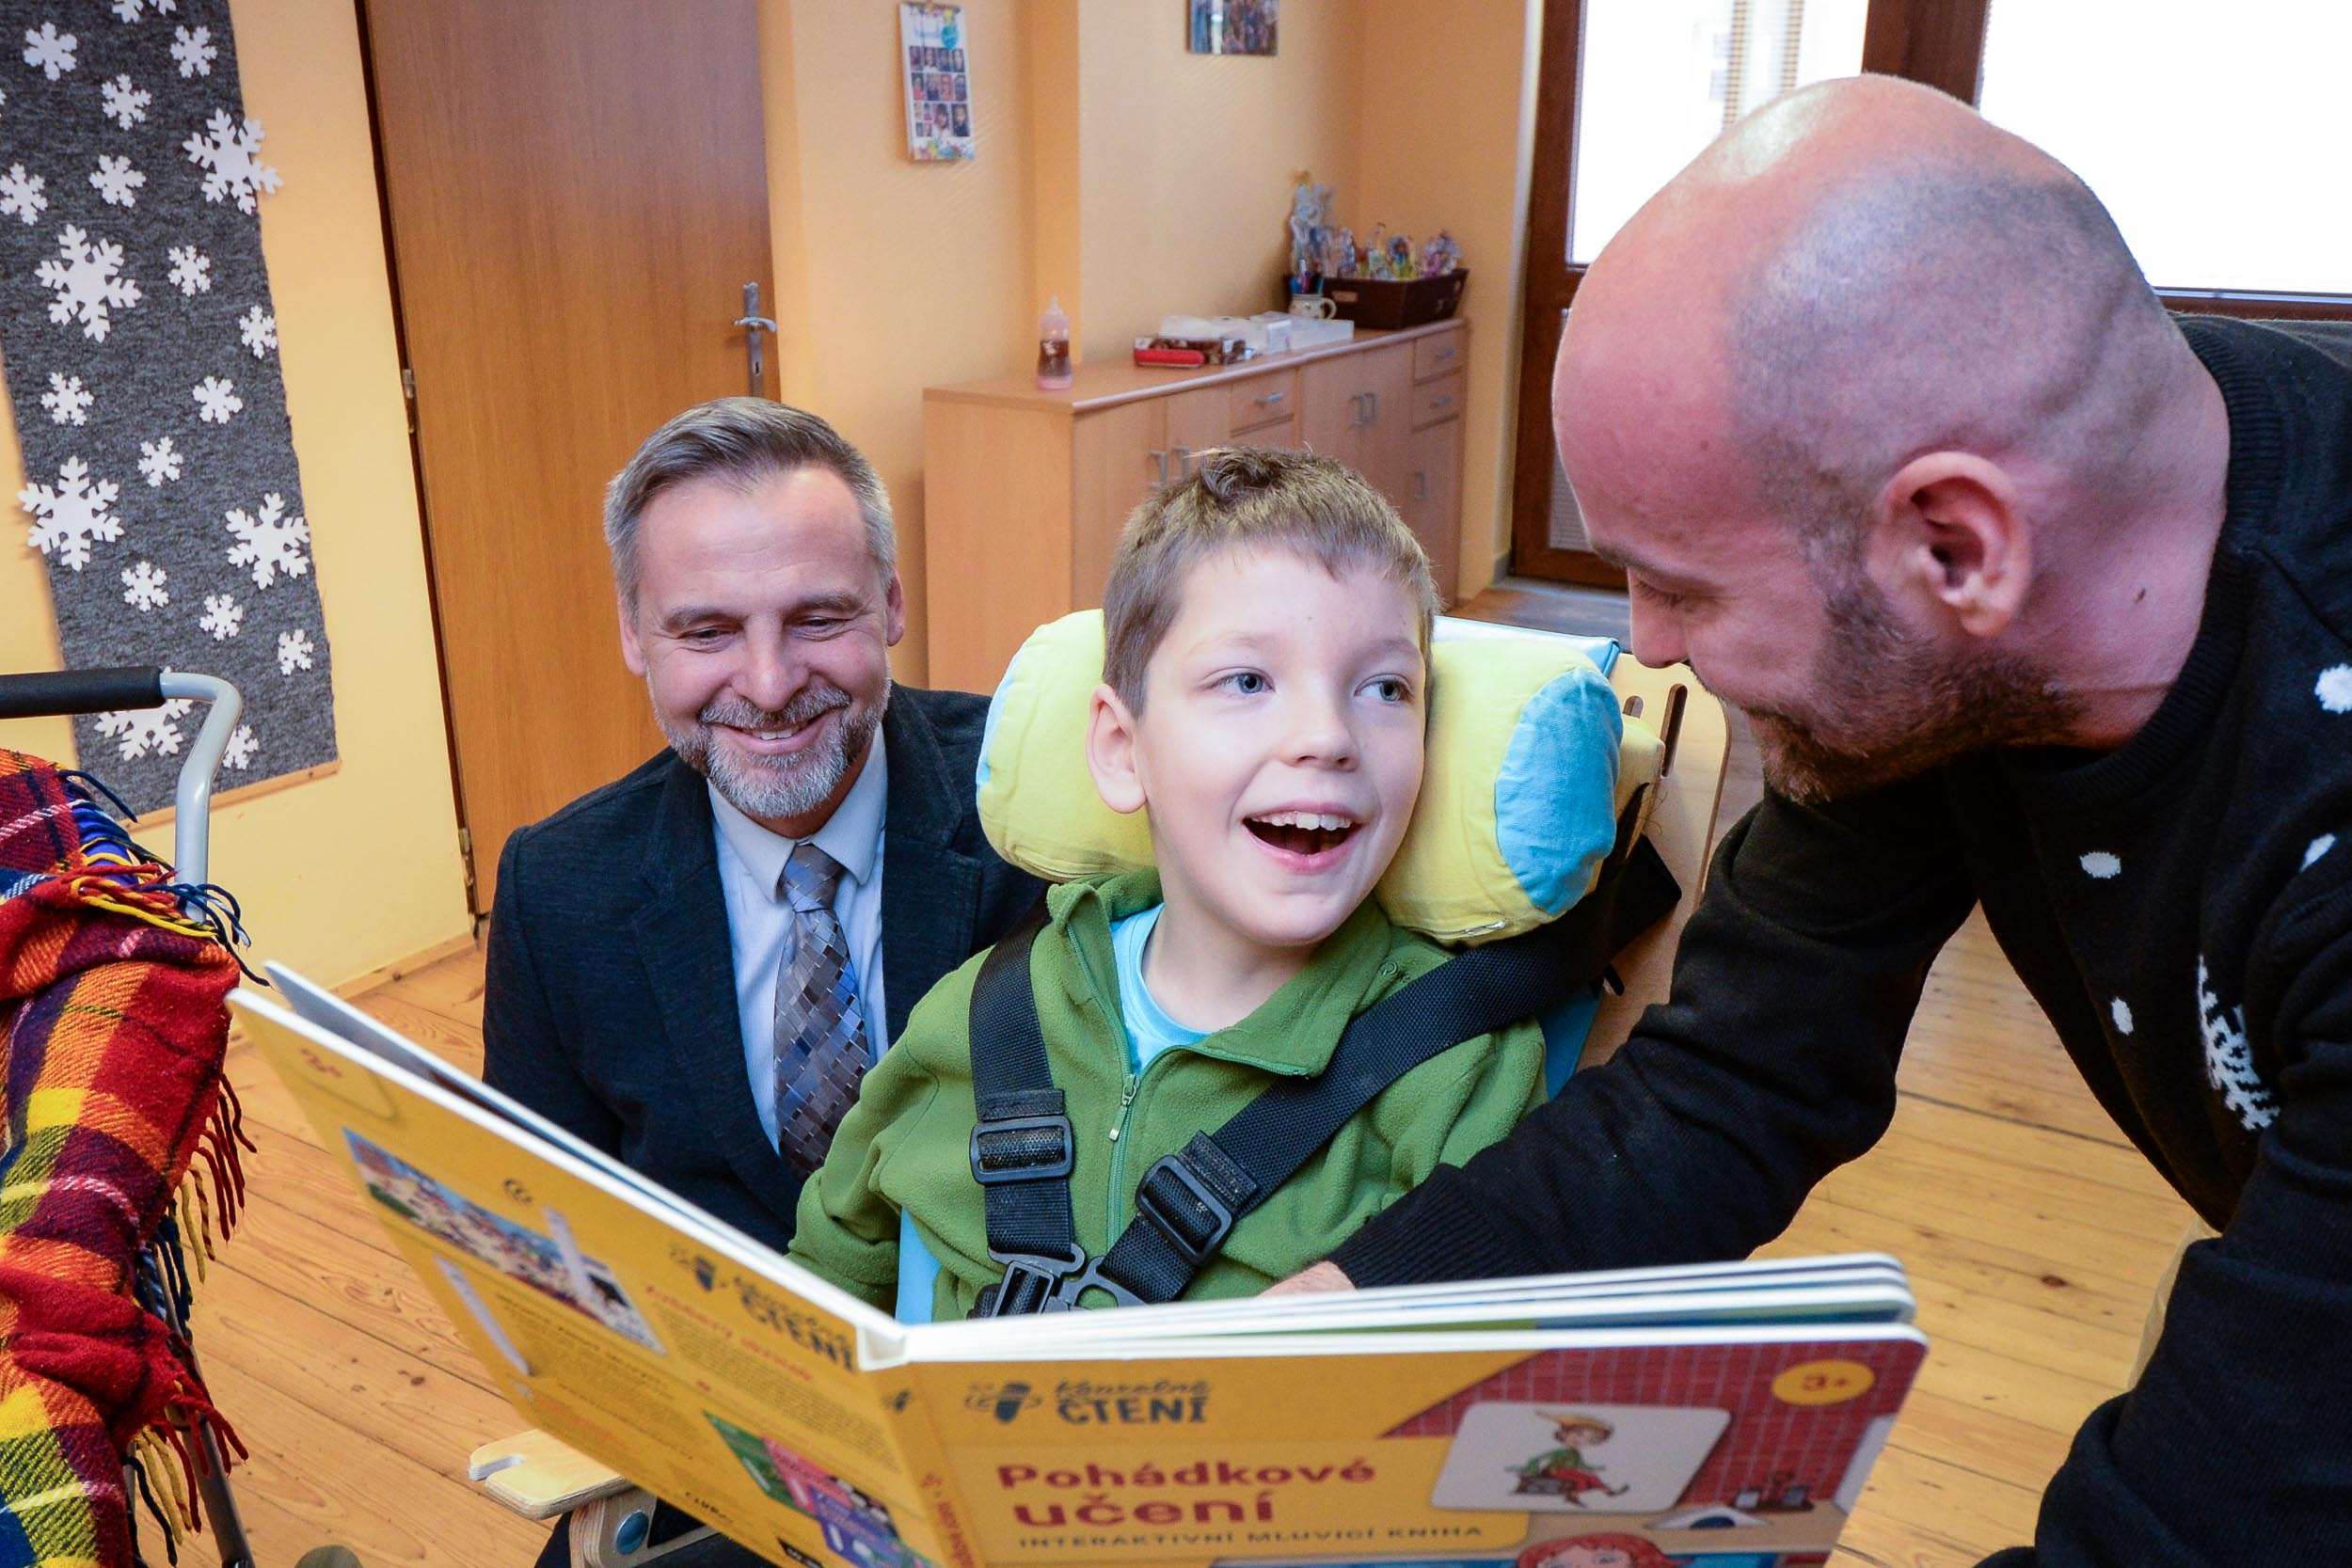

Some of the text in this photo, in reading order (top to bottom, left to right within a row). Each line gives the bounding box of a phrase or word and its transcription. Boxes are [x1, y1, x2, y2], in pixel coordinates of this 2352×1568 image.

[1803, 1373, 1851, 1392] 3+
[1056, 1396, 1208, 1425] ČTENÍ
[997, 1457, 1376, 1489] Pohádkové
[1012, 1490, 1275, 1528] učení
[1388, 1525, 1483, 1538] KNIHA
